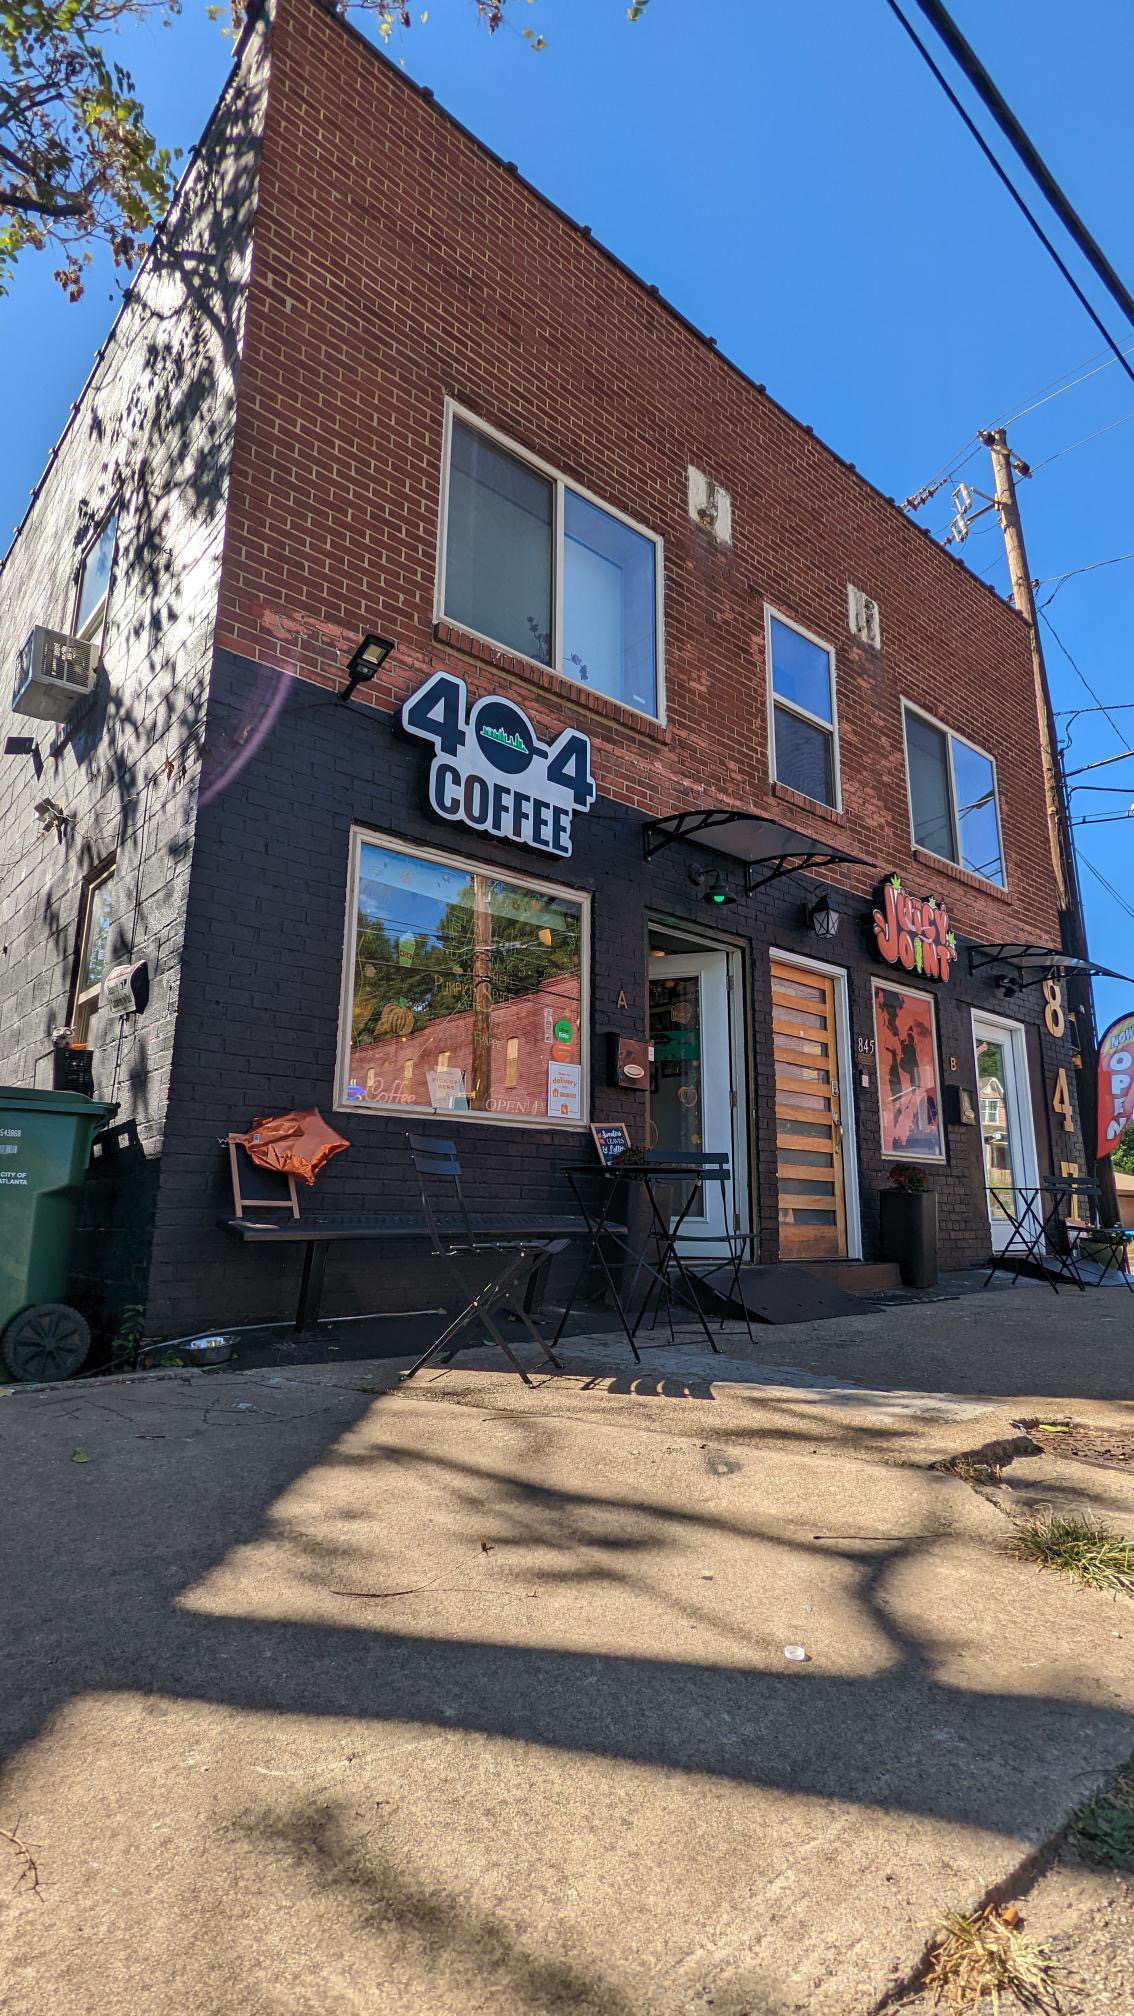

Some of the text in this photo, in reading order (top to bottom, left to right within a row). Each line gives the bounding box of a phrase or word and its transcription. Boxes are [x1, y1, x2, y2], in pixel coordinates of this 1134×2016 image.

[434, 763, 570, 854] COFFEE
[616, 990, 628, 1010] A
[858, 1038, 875, 1055] 845
[950, 1056, 958, 1072] B
[552, 1076, 578, 1089] delivery
[1106, 1051, 1132, 1141] OPEN
